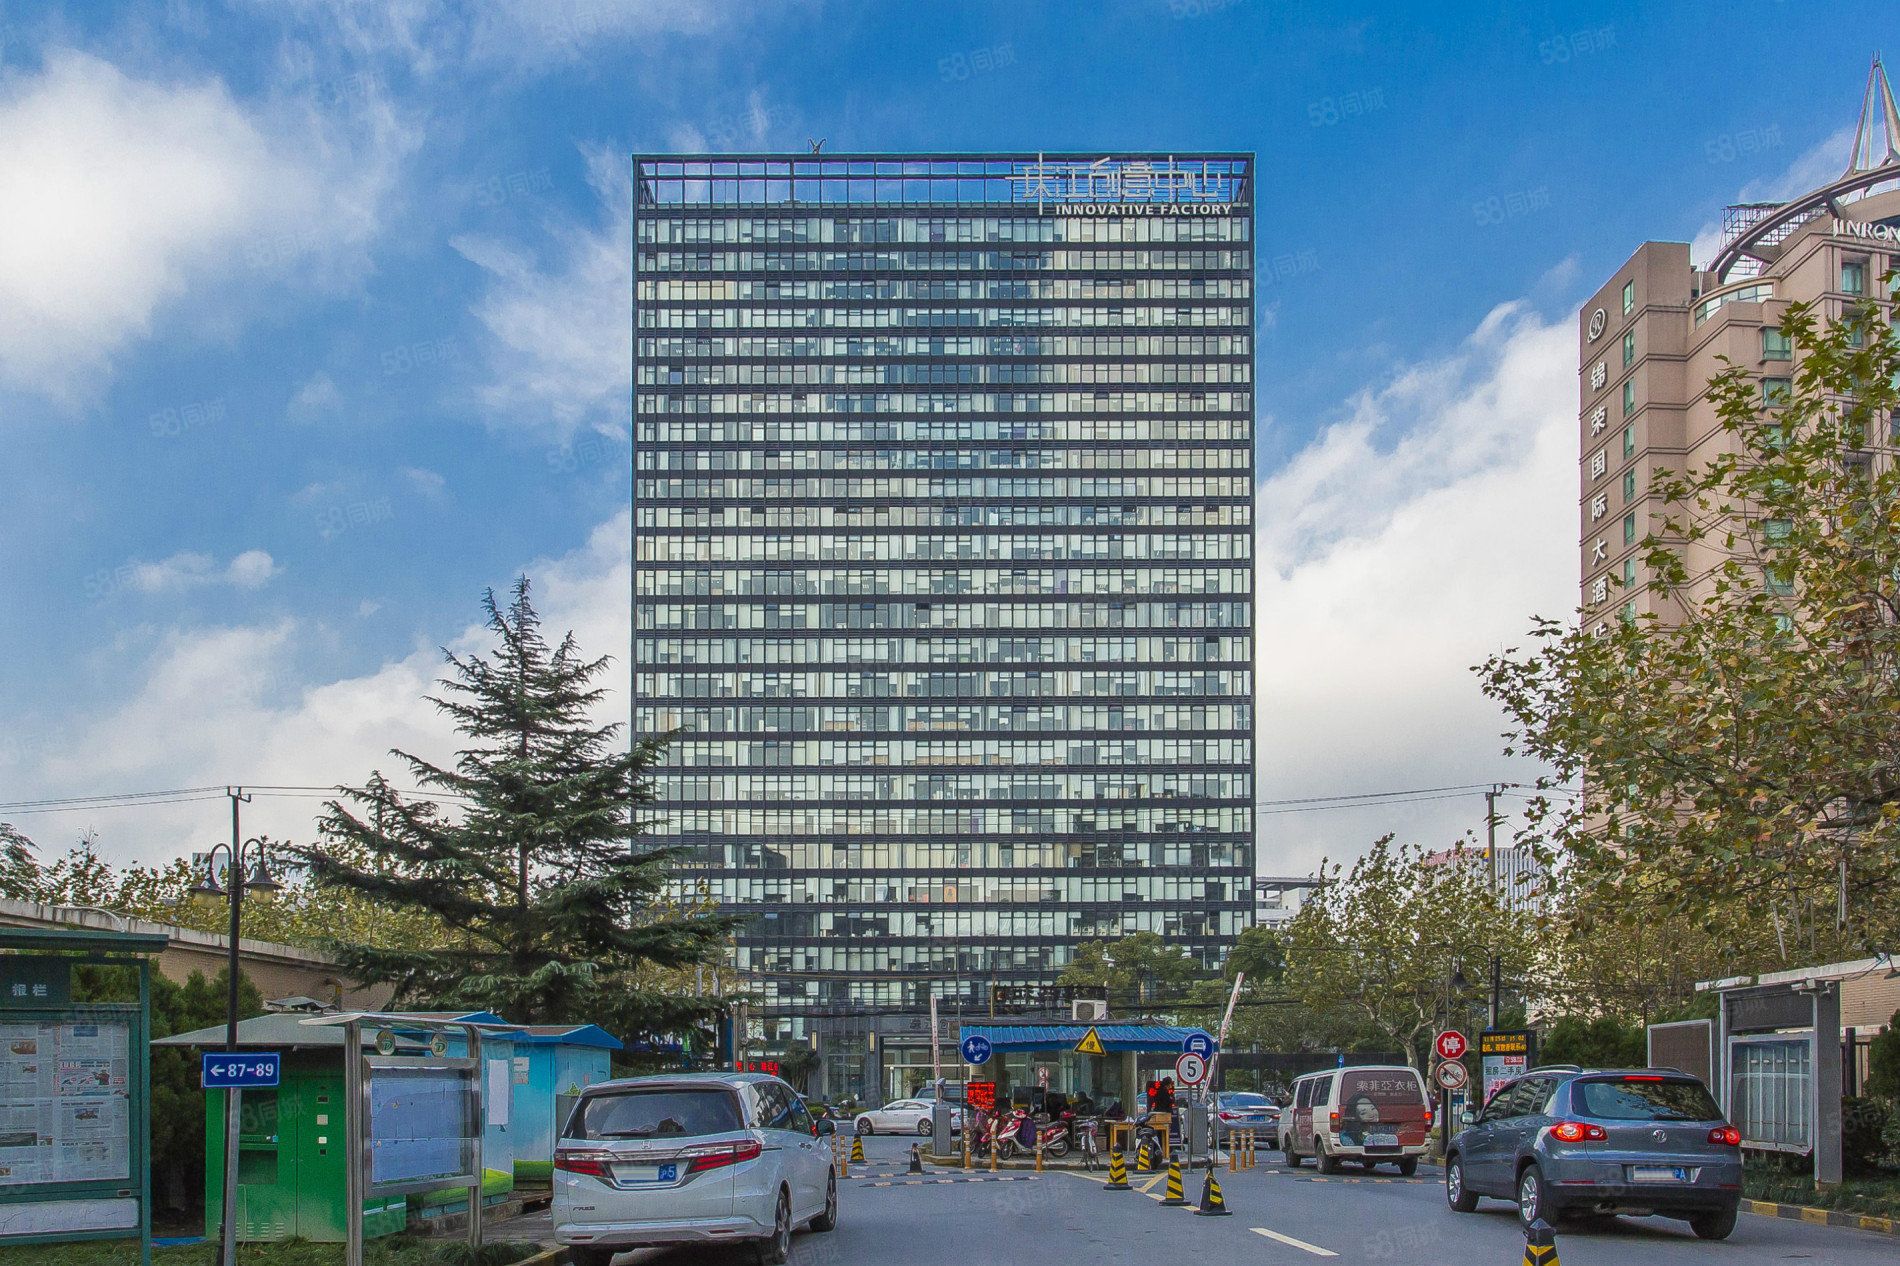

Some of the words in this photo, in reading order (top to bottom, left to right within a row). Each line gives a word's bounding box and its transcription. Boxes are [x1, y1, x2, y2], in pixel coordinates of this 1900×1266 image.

[1056, 204, 1154, 215] INNOVATIVE
[1160, 204, 1232, 215] FACTORY
[12, 983, 48, 996] 报栏
[1442, 1037, 1461, 1054] 停
[227, 1063, 274, 1077] 87-89
[1187, 1061, 1197, 1077] 5
